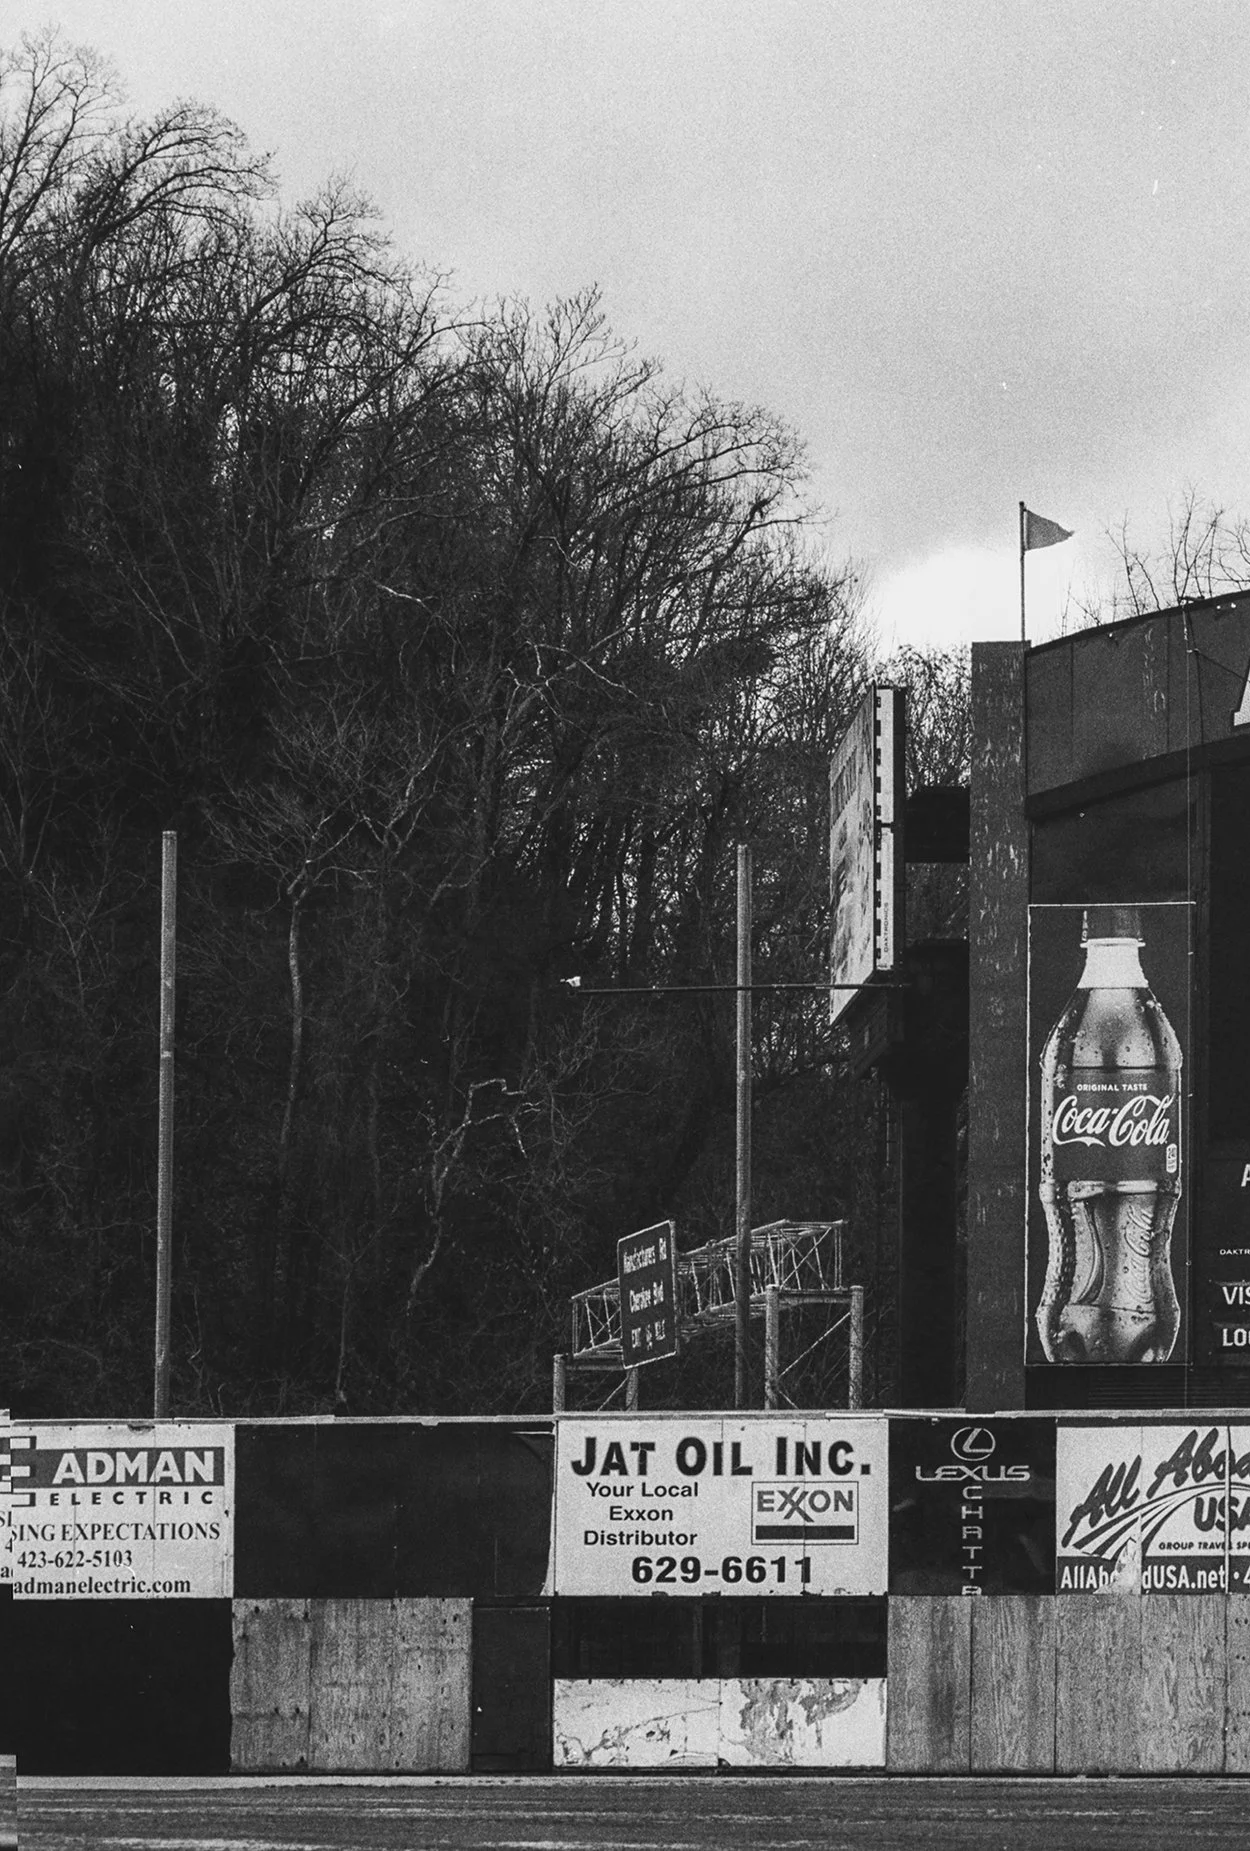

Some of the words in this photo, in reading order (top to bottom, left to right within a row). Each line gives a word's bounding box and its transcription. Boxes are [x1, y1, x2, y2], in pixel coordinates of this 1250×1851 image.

[1077, 1084, 1119, 1092] ORIGINAL
[1122, 1083, 1148, 1091] TASTE
[1052, 1095, 1177, 1147] Coca-Cola
[571, 1437, 656, 1477] JAT
[676, 1437, 753, 1477] OIL
[776, 1437, 871, 1477] INC.
[52, 1451, 215, 1485] ADMAN
[915, 1465, 1031, 1482] LEXUS
[50, 1491, 213, 1507] ELECTRIC
[586, 1482, 634, 1498] Your
[641, 1482, 698, 1498] Local
[756, 1486, 854, 1523] EXXON
[1062, 1455, 1142, 1548] All
[609, 1506, 674, 1522] Exxon
[62, 1523, 220, 1544] EXPECTATIONS
[584, 1530, 698, 1546] Distributor
[1159, 1542, 1194, 1550] GROUP
[17, 1550, 132, 1569] 423-622-5103
[631, 1556, 811, 1584] 629-6611
[14, 1576, 191, 1595] admanelectric.com
